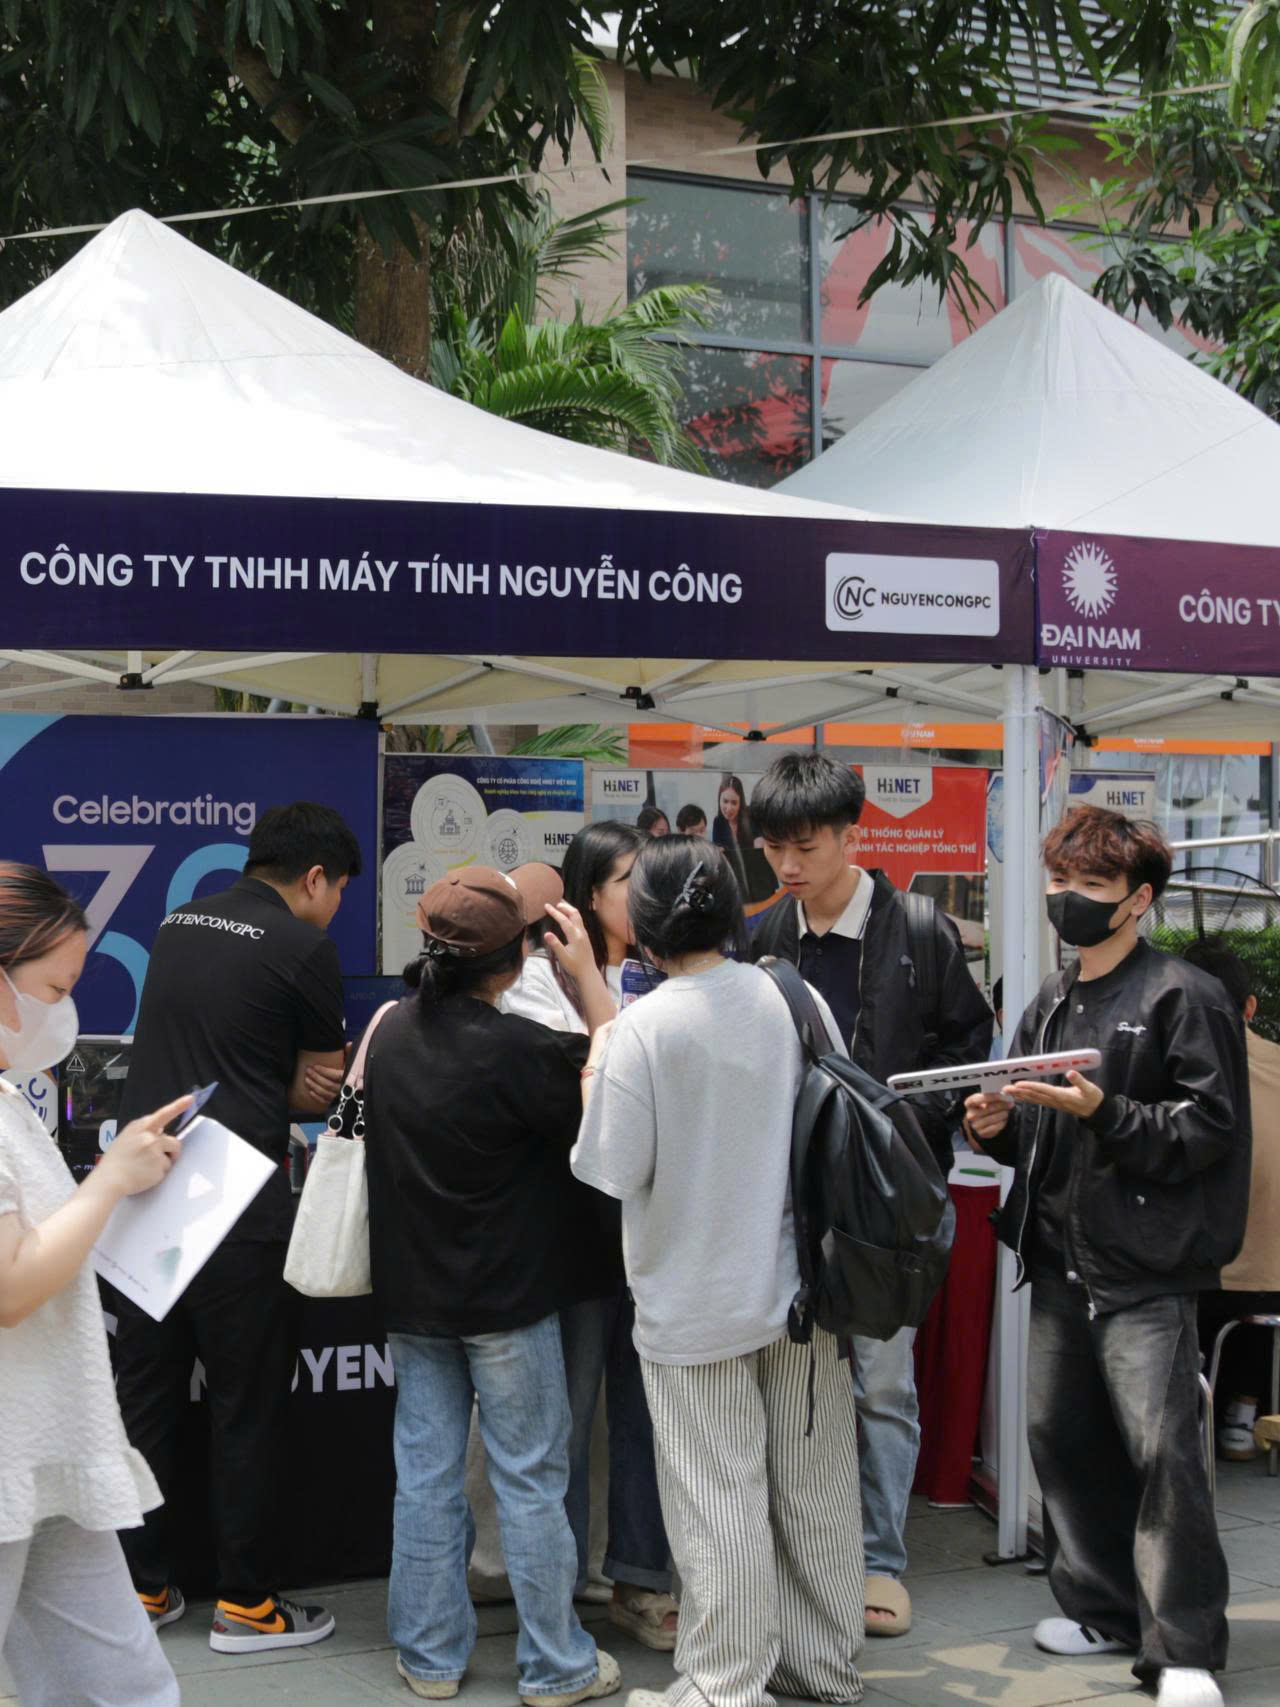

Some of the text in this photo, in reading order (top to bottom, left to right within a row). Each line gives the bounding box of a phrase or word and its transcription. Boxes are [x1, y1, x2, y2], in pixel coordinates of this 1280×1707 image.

[20, 543, 743, 603] CÔNG TY TNHH MÁY TÍNH NGUYỄN CÔNG
[880, 592, 992, 609] NGUYENCONGPC
[1178, 588, 1252, 625] CÔNG
[1041, 623, 1141, 651] ĐẠI NAM
[1051, 655, 1132, 667] UNIVERSITY
[603, 779, 640, 792] HiNET
[877, 778, 921, 794] HiNET
[1106, 791, 1146, 806] HiNET
[52, 793, 256, 835] Celebrating
